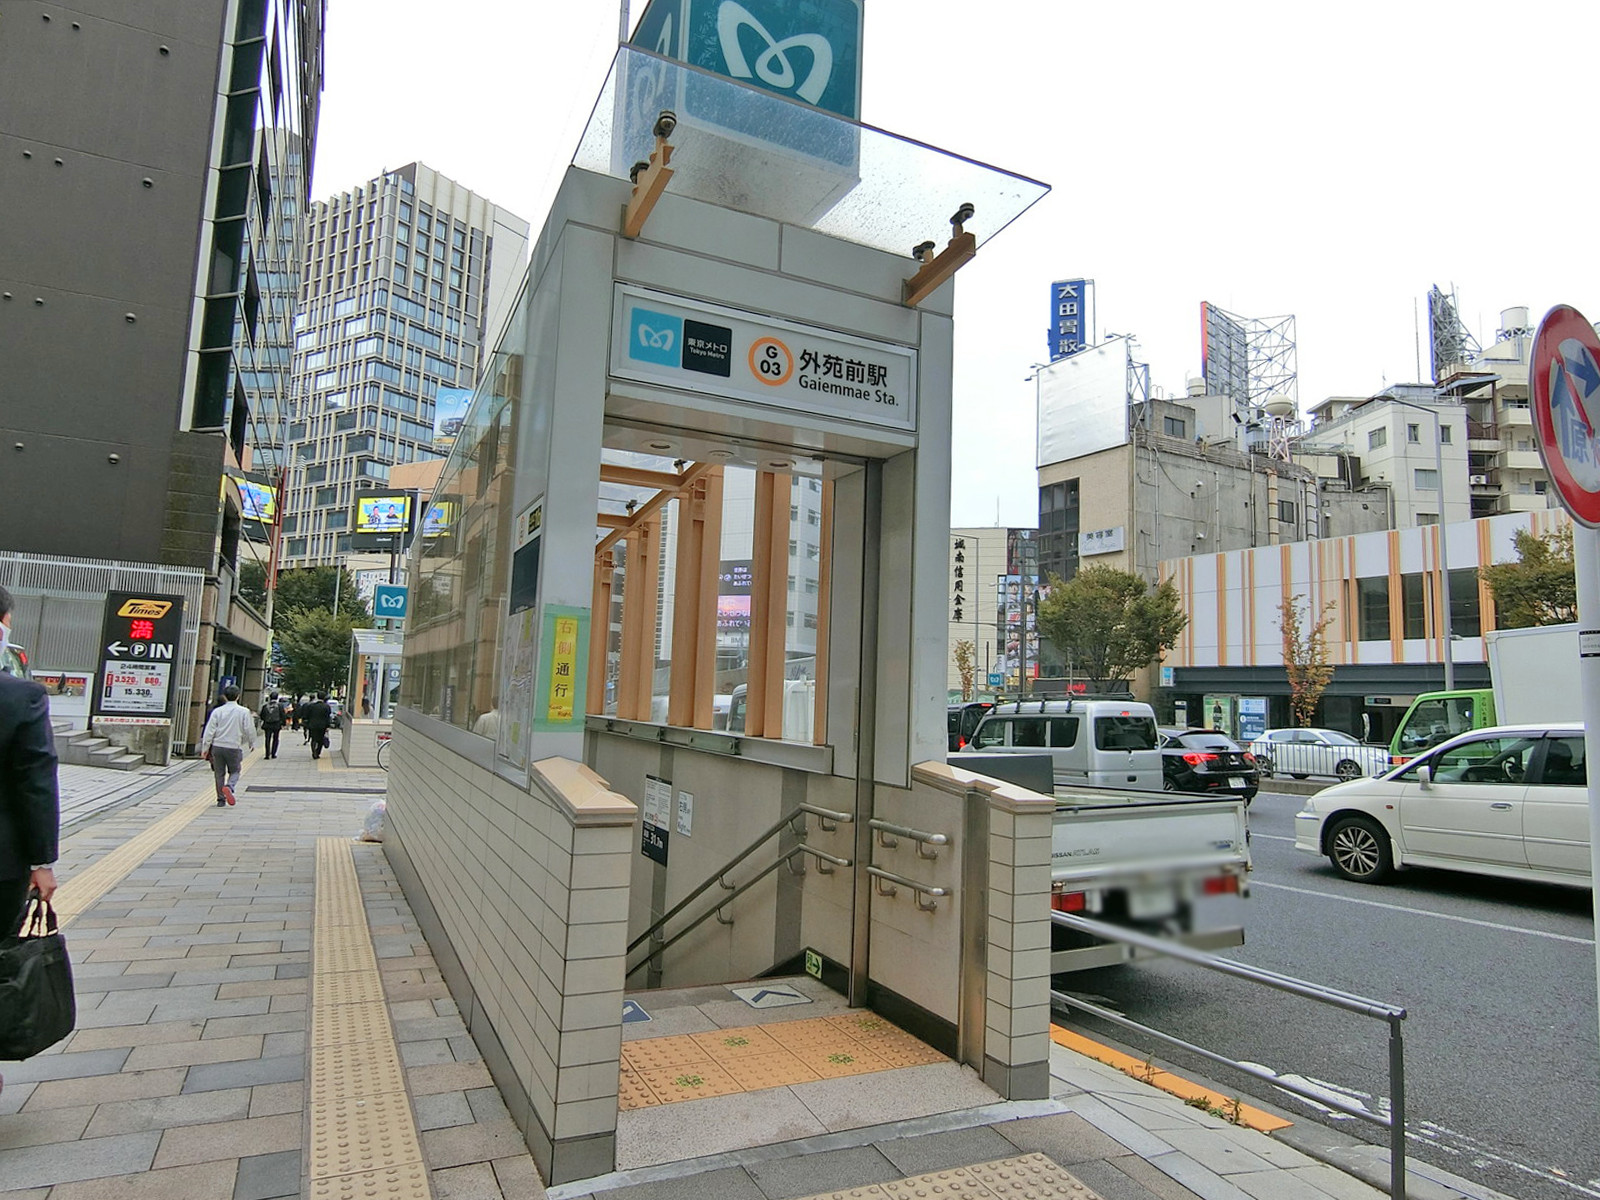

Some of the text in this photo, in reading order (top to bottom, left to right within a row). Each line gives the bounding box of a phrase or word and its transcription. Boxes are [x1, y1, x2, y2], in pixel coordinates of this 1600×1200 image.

[687, 337, 728, 353] 東京メトロ
[690, 346, 726, 359] Tokyo Metro
[765, 345, 778, 359] G
[759, 359, 781, 376] 03
[799, 349, 888, 388] 外苑前駅
[798, 374, 900, 407] Gaiemmae Sta.
[952, 537, 966, 623] 城南信用金庫
[128, 603, 163, 615] Times
[130, 619, 155, 639] 満
[149, 643, 173, 659] IN
[555, 620, 573, 698] 右側通行
